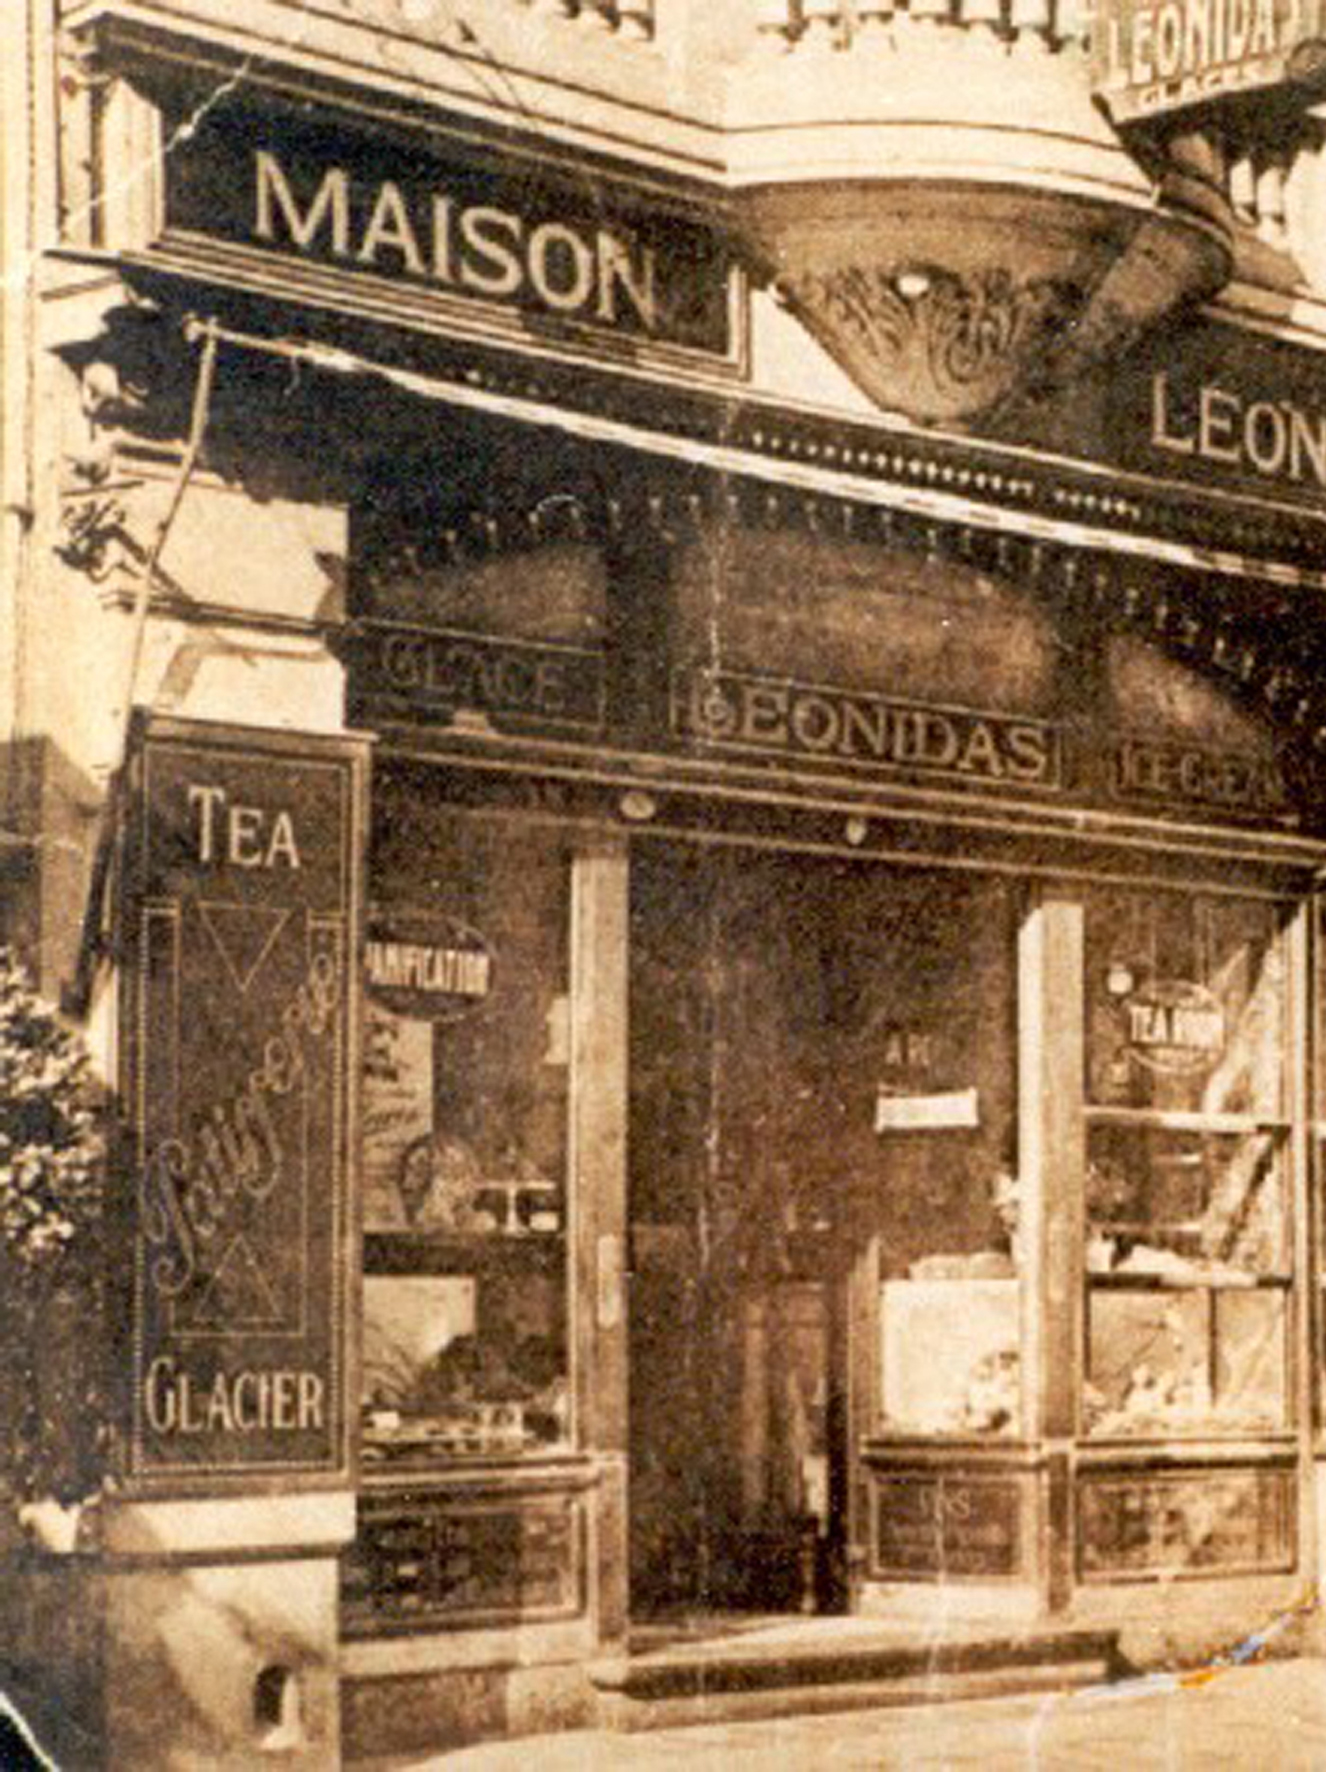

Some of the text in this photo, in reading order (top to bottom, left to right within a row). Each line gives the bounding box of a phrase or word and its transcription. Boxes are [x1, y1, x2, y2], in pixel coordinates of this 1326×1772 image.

[253, 149, 660, 331] MAISON
[690, 676, 1049, 779] LEONIDAS
[187, 784, 300, 869] TEA
[145, 1354, 325, 1434] GLACIER
